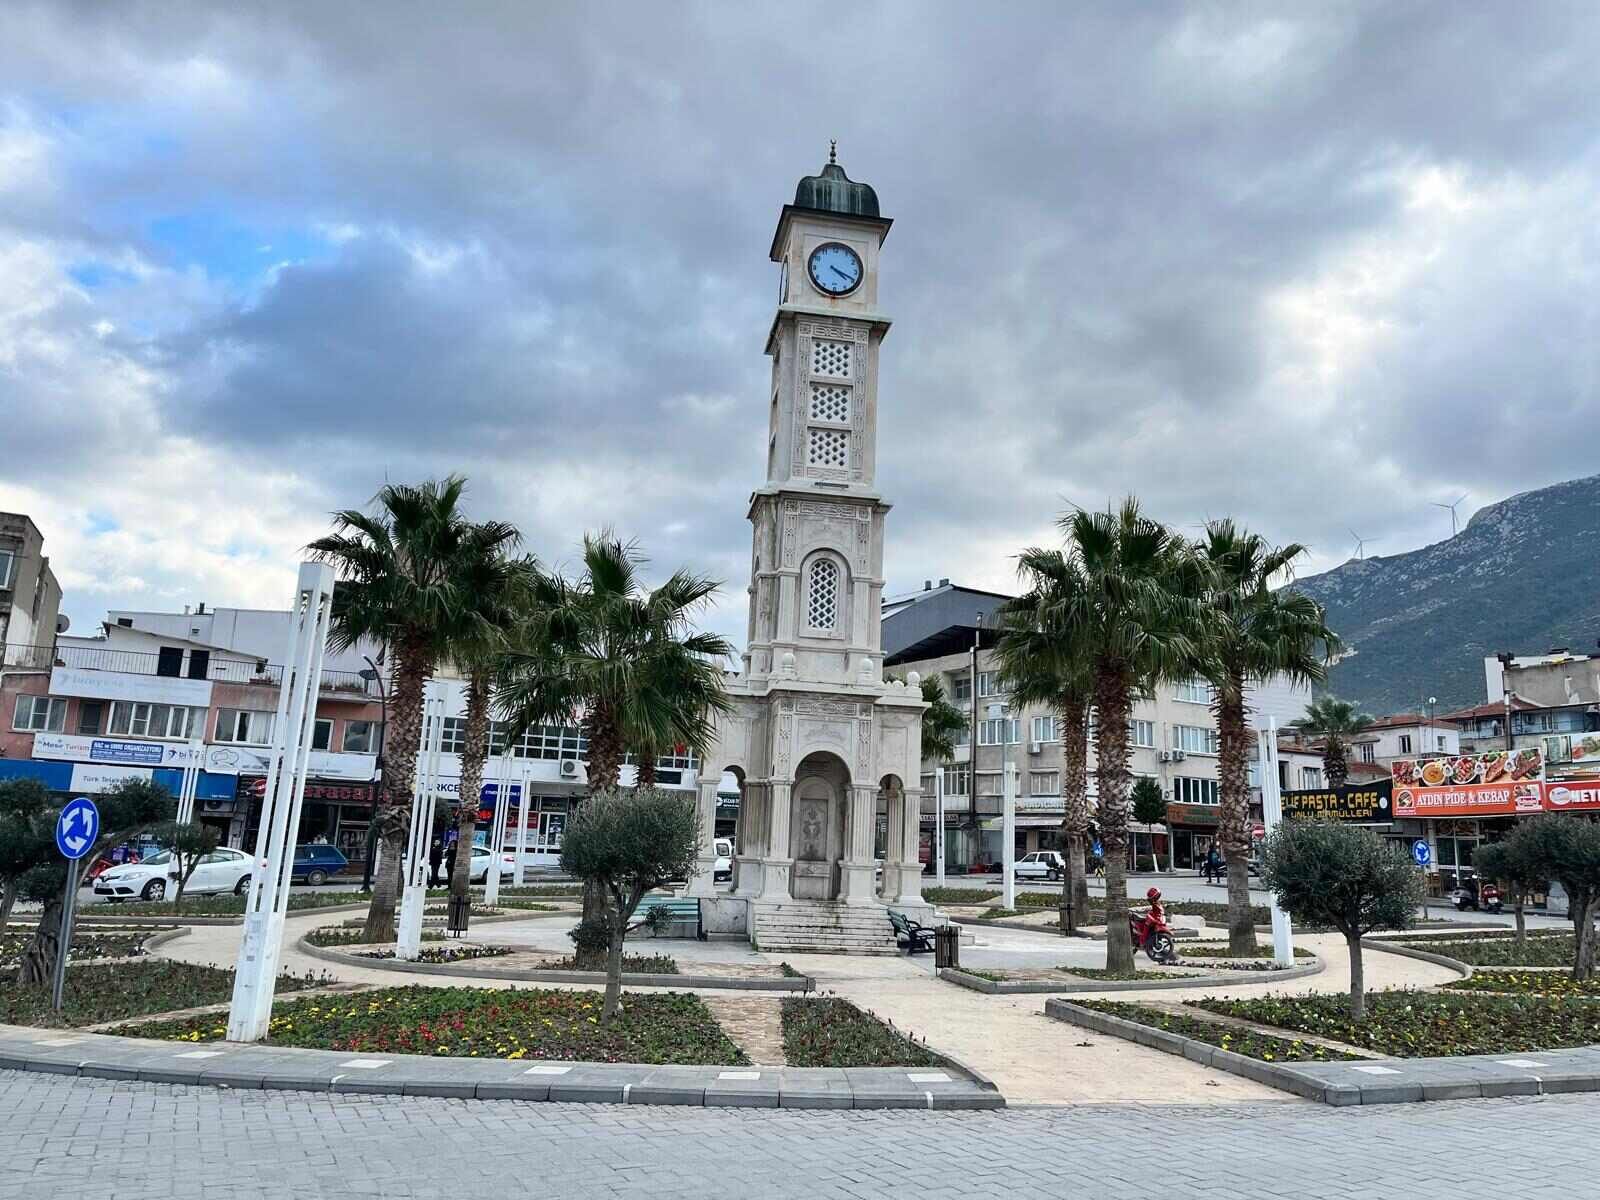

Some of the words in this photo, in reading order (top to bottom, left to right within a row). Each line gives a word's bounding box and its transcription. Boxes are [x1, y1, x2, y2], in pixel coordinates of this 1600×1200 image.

[1301, 793, 1338, 809] PASTA
[1347, 791, 1379, 809] CAFE
[1416, 792, 1443, 806] AYDIN
[1477, 790, 1510, 804] KEBAP
